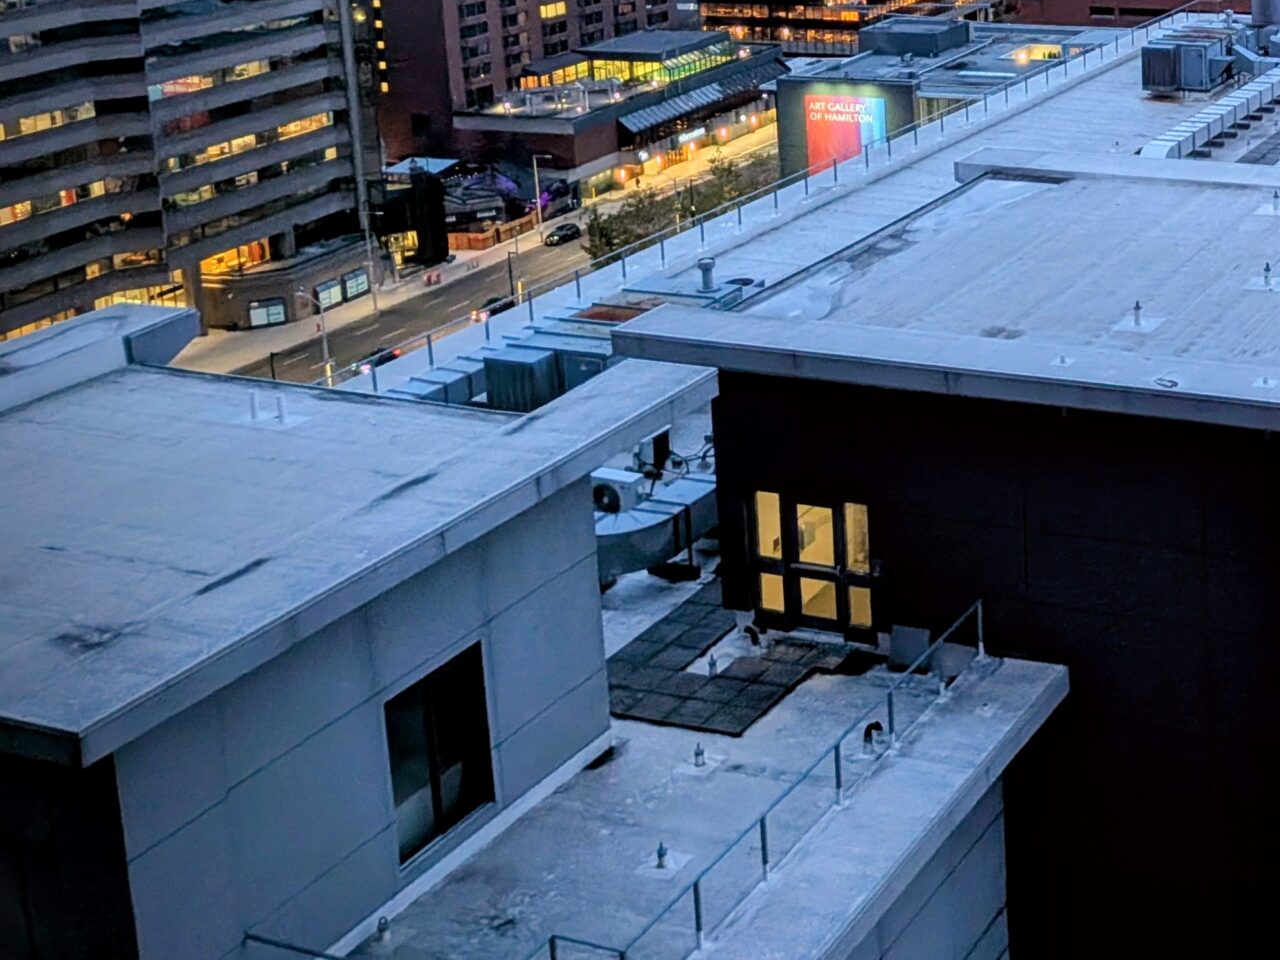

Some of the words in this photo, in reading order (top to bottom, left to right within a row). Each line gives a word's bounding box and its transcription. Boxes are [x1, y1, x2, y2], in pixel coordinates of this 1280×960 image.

[809, 102, 826, 111] ART
[828, 102, 866, 113] GALLERY
[809, 111, 823, 121] OF
[824, 112, 874, 123] HAMILTON
